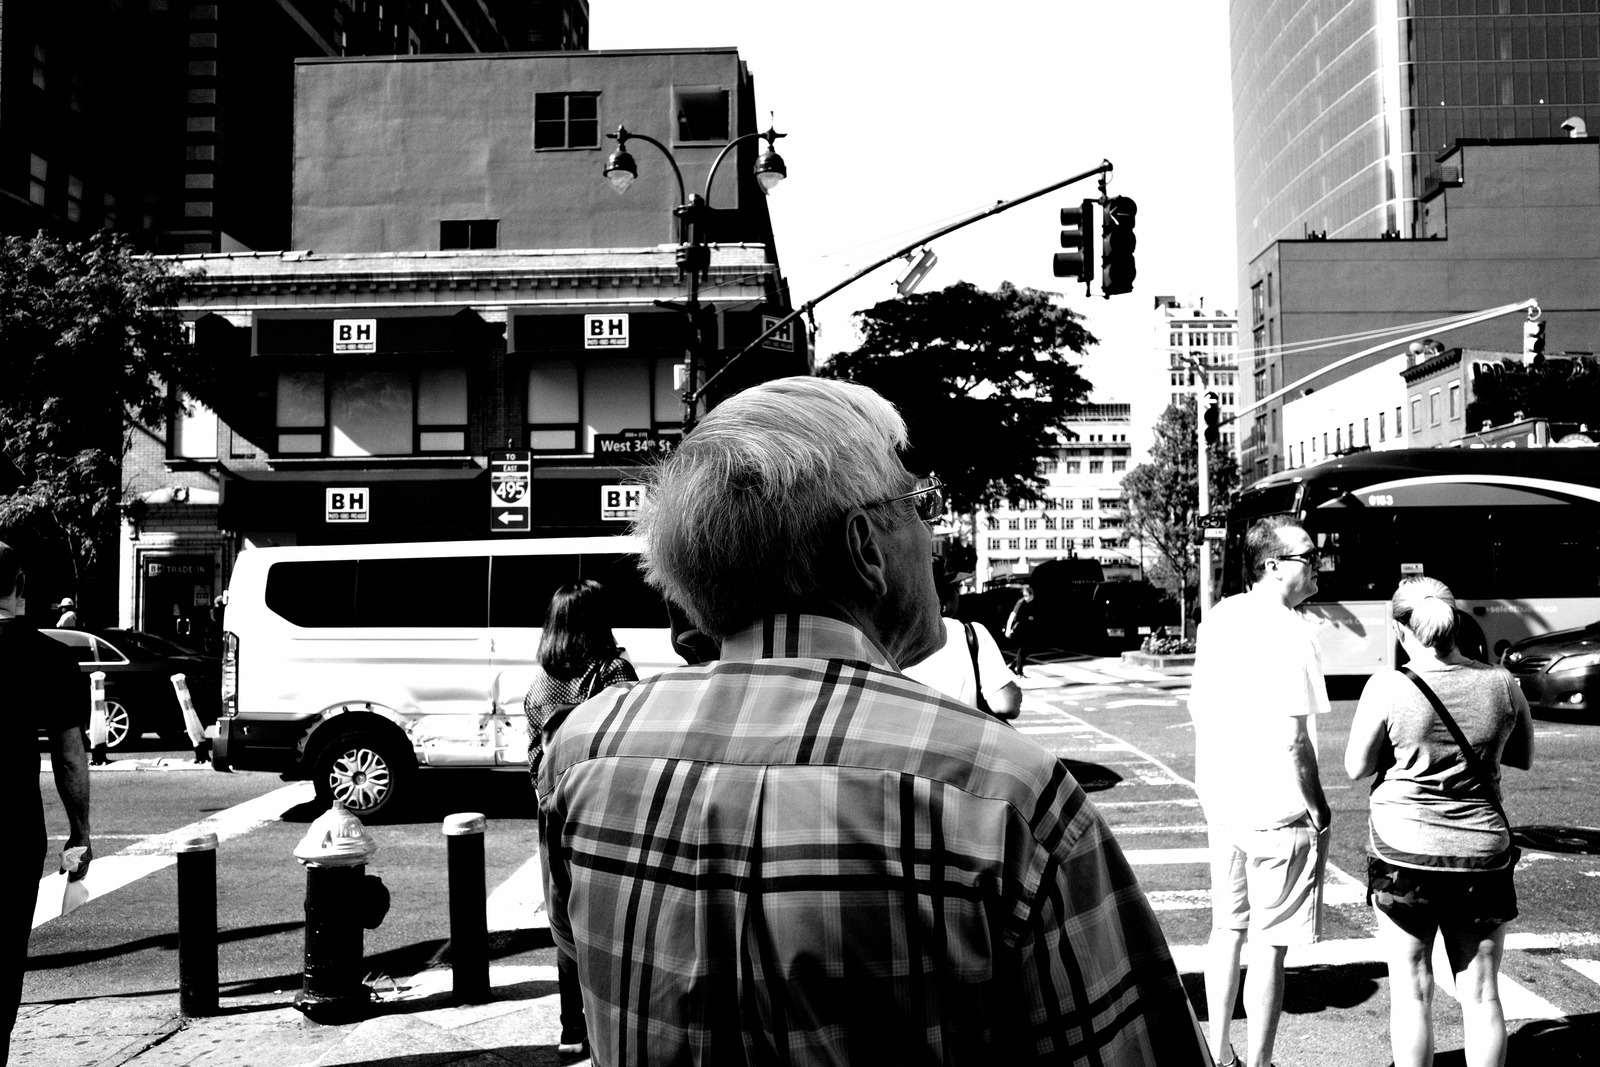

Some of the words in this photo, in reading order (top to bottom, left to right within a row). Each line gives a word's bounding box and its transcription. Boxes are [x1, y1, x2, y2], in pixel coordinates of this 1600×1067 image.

[600, 439, 631, 452] West
[633, 439, 656, 452] 34th
[658, 439, 671, 452] St
[505, 453, 516, 461] TO
[503, 464, 518, 472] EAST
[495, 481, 526, 499] 495
[166, 565, 193, 574] TRADE
